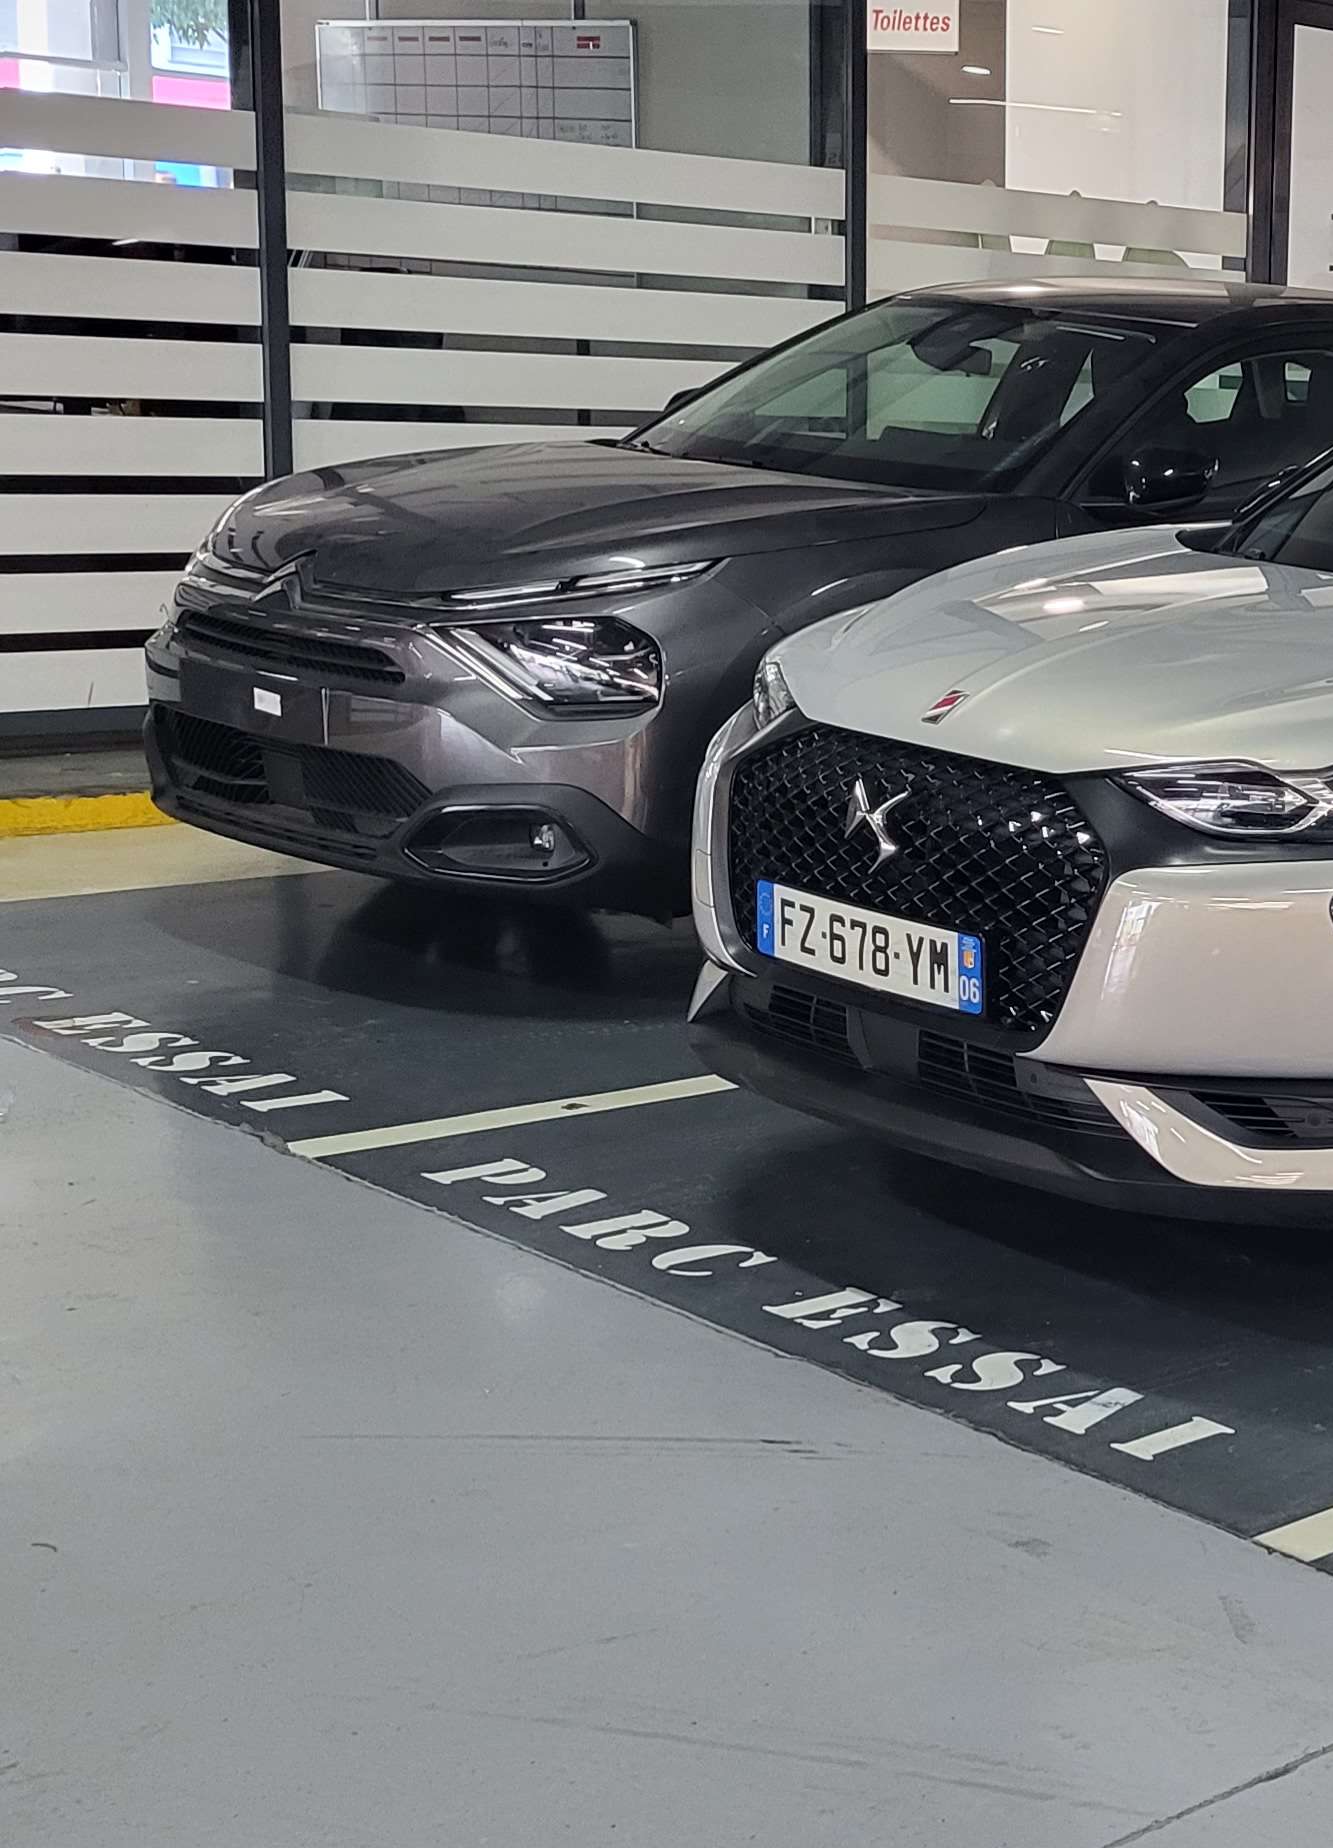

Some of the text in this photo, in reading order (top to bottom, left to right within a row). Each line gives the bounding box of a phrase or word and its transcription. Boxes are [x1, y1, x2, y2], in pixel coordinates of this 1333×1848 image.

[872, 8, 951, 32] Toilettes
[762, 923, 770, 939] F
[779, 897, 950, 994] FZ-678-YM
[959, 975, 980, 1003] 06
[32, 1011, 351, 1113] ESSAI
[420, 1158, 1236, 1462] PARC ESSAI
